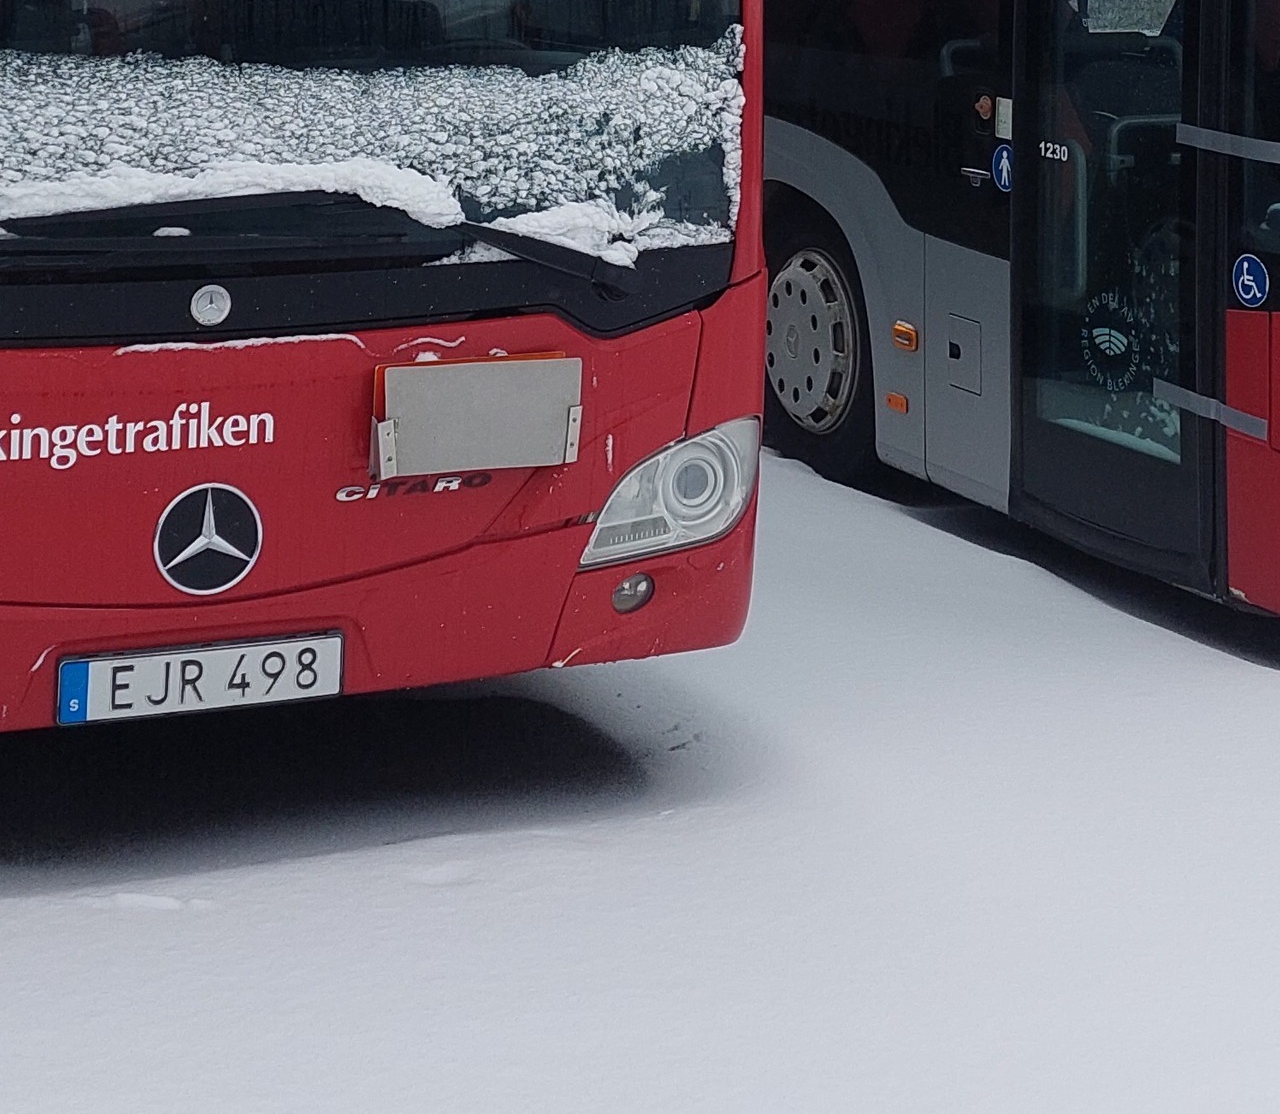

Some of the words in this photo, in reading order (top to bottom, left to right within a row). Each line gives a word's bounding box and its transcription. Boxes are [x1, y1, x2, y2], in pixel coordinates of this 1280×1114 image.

[1039, 141, 1068, 162] 1230
[1081, 329, 1104, 385] REGION
[110, 659, 204, 711] EJR
[226, 647, 318, 698] 498
[69, 699, 79, 712] S
